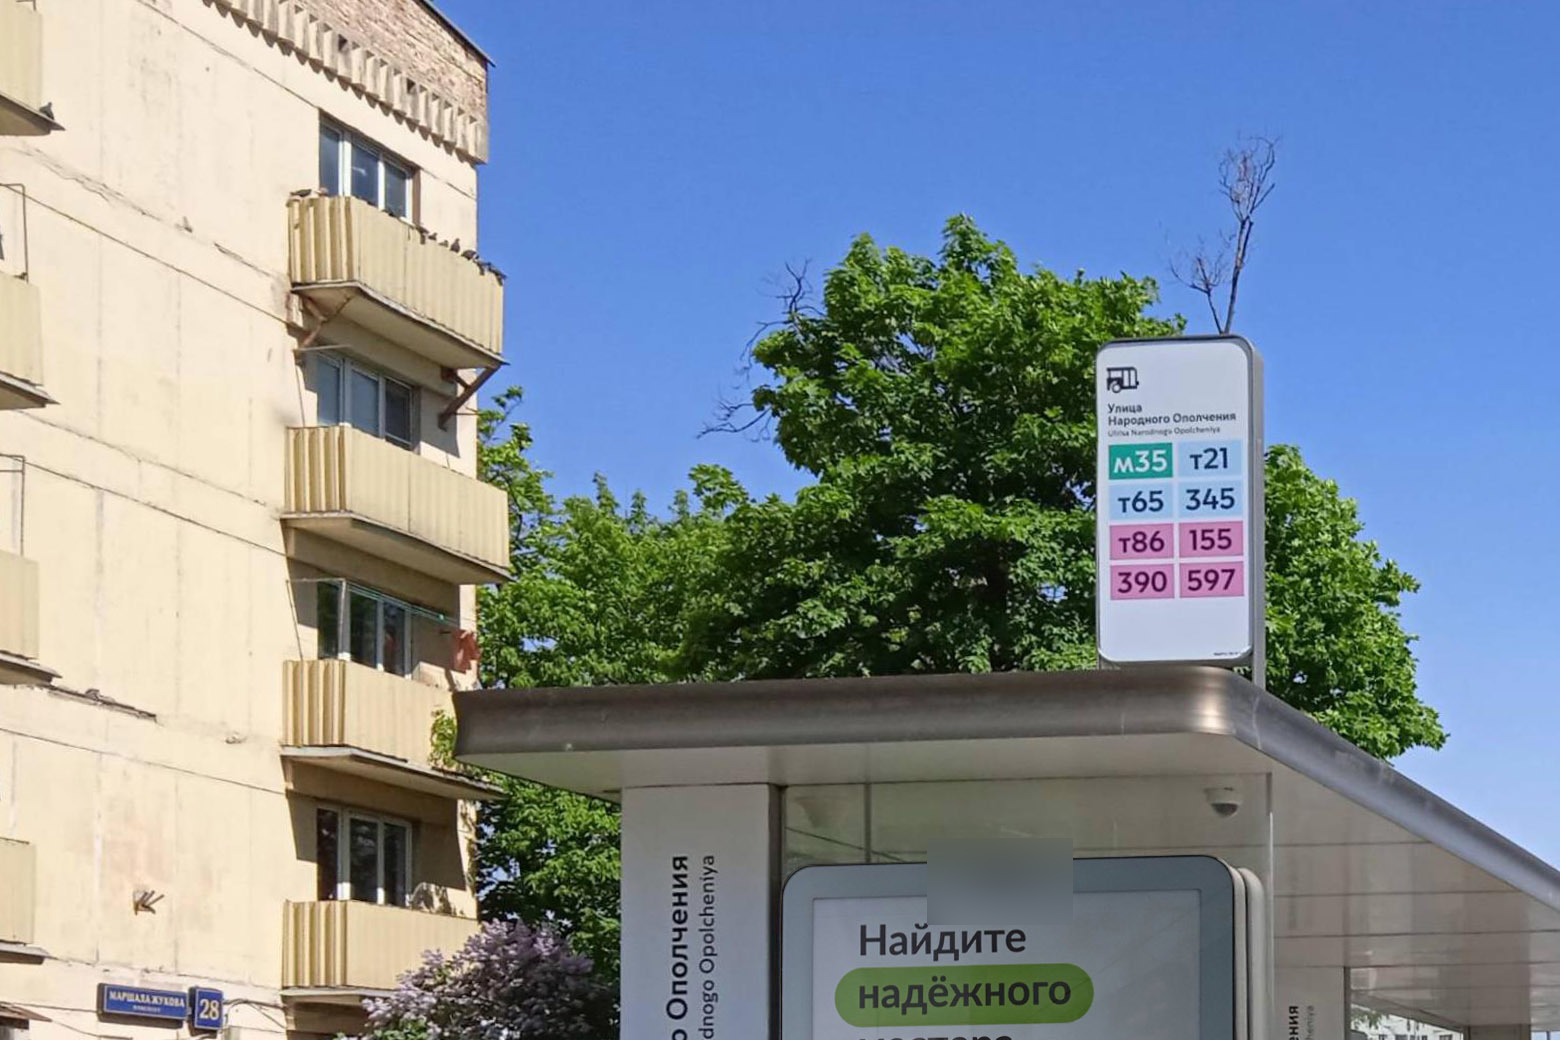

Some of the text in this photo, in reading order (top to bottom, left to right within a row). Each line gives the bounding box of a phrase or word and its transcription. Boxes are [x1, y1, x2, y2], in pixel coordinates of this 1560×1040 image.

[1107, 403, 1142, 414] Улица
[1108, 412, 1236, 427] Народного Ополчения
[1185, 487, 1236, 510] 345
[1189, 528, 1232, 551] 155
[1117, 568, 1236, 593] 390 597
[697, 854, 719, 974] Opolcheniya
[664, 855, 690, 1021] Ополчения
[859, 921, 1027, 960] Найдите
[858, 973, 1071, 1014] надёжного
[199, 998, 220, 1021] 28
